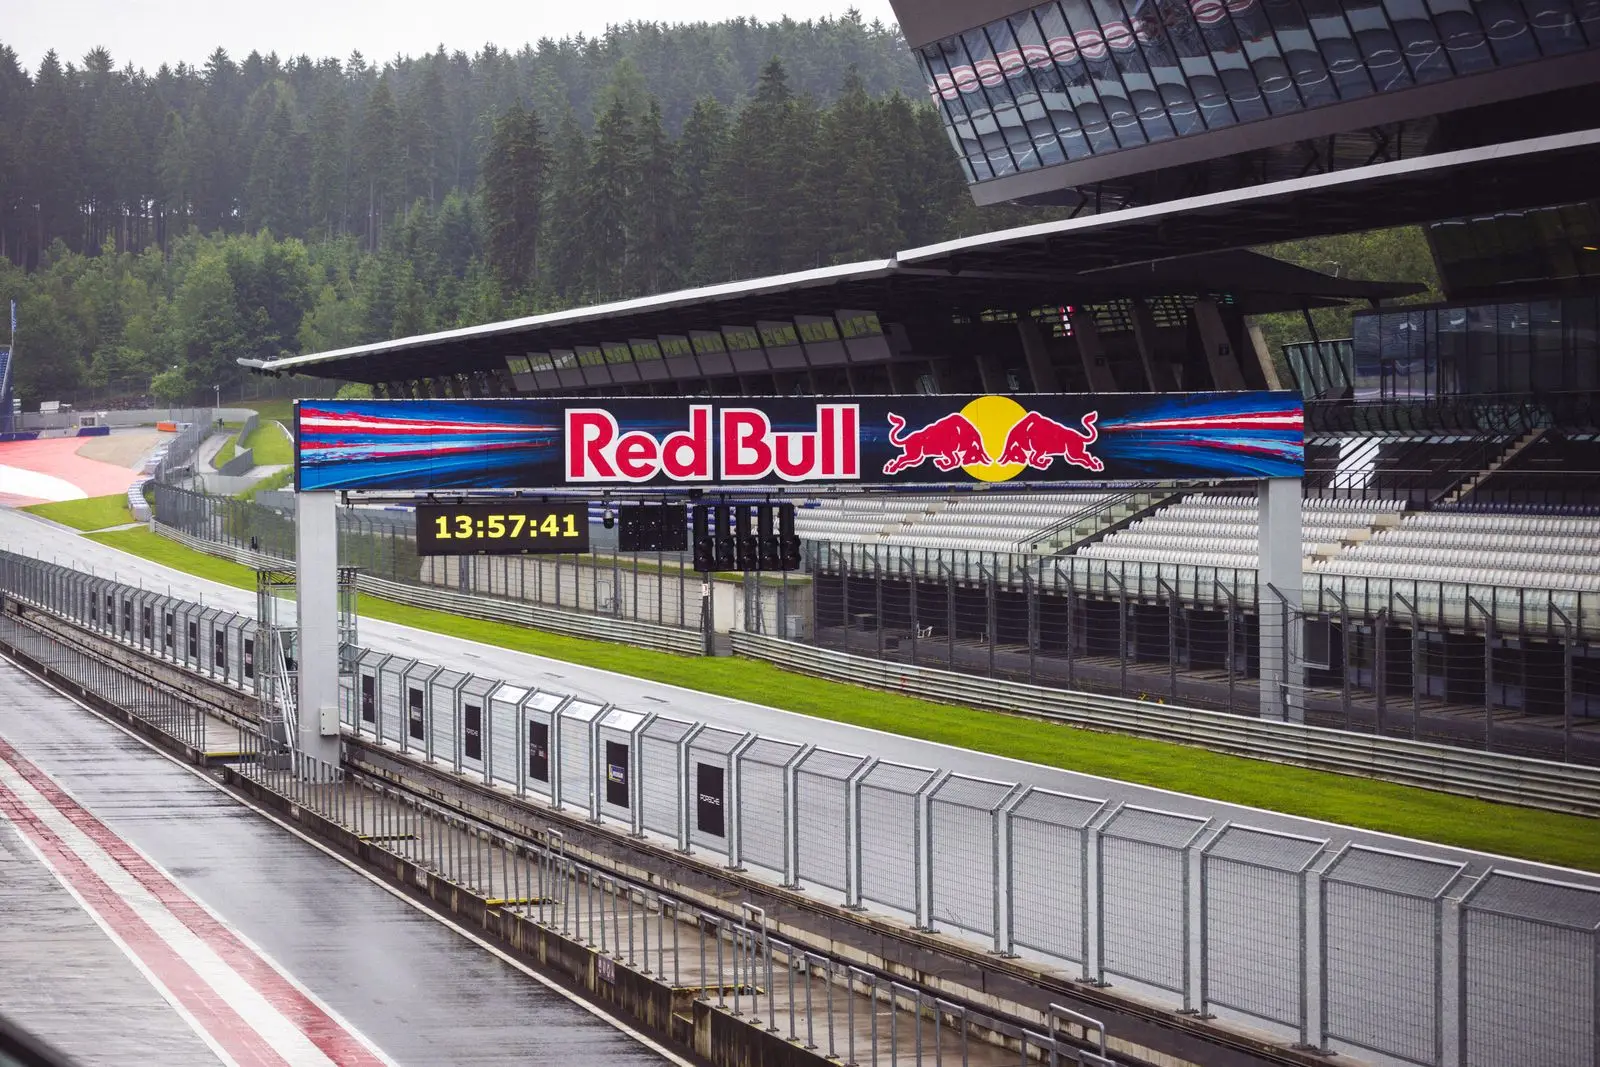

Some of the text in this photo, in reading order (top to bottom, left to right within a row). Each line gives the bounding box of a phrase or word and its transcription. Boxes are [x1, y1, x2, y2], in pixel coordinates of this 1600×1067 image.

[565, 404, 860, 482] Red Bull
[435, 514, 579, 539] 13:57:41
